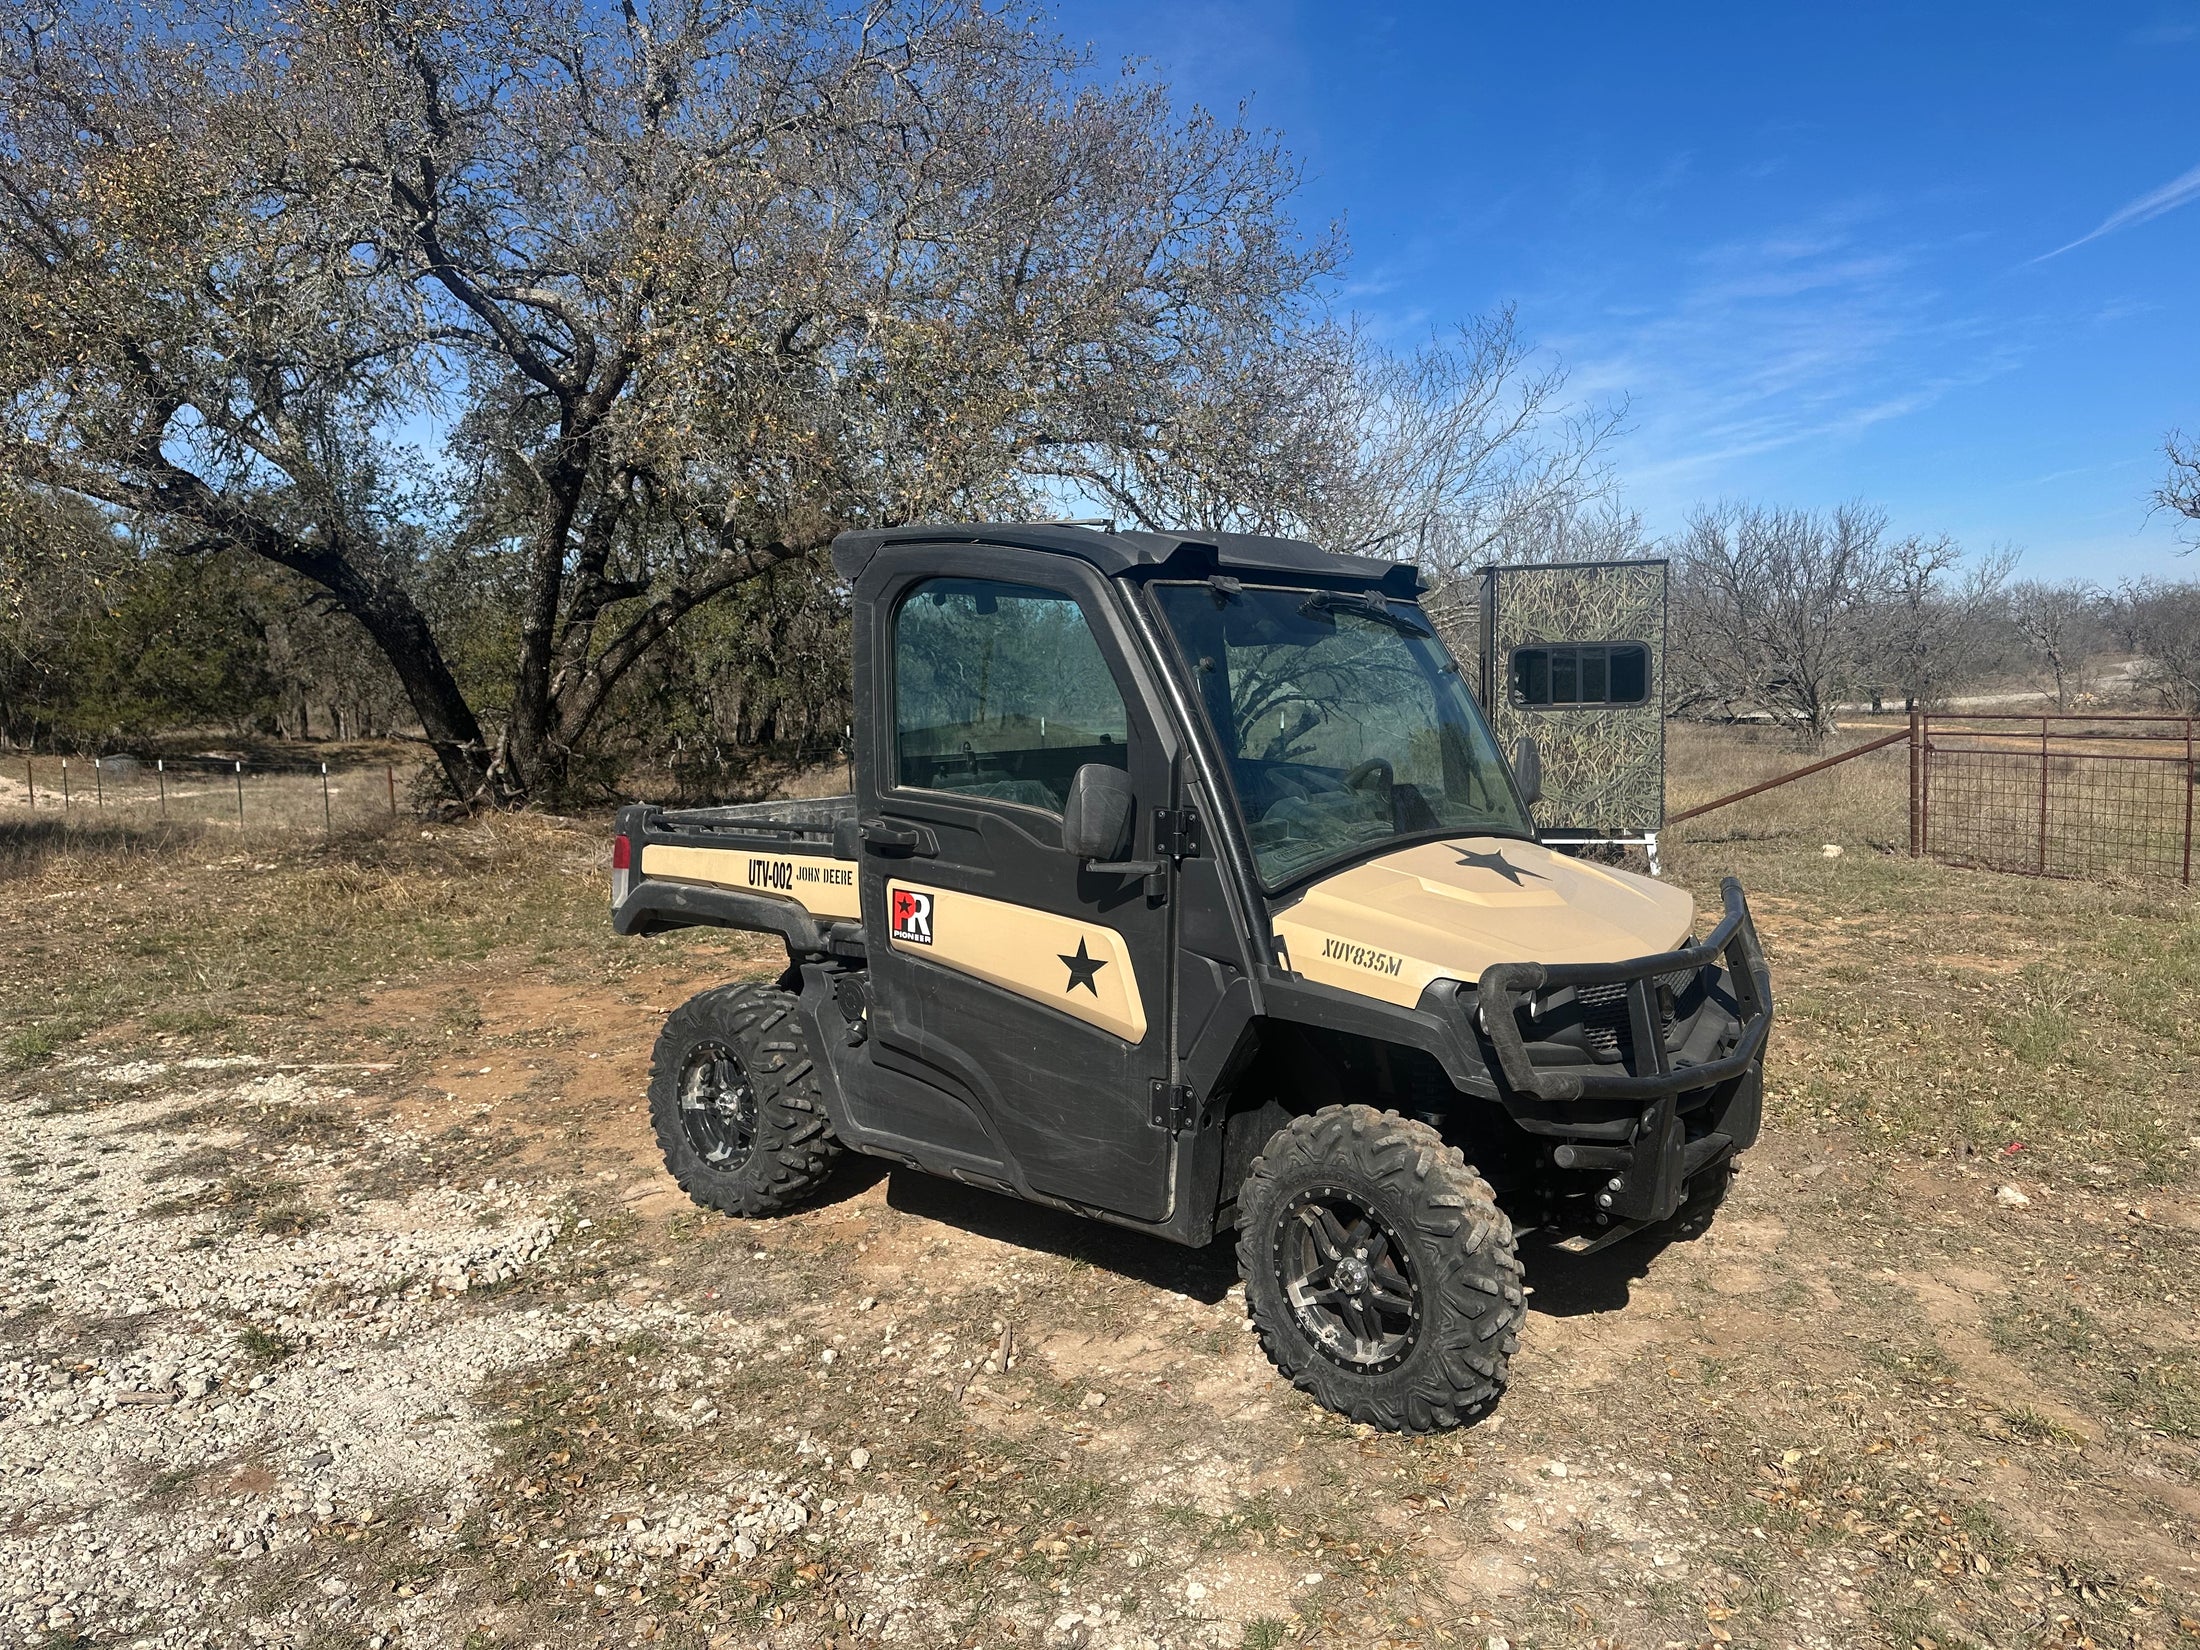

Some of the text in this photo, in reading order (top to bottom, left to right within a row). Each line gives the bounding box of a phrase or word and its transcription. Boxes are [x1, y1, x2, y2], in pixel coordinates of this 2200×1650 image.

[748, 859, 793, 890] UTV-002
[796, 866, 853, 885] JOHN DEERE
[893, 930, 932, 943] PIONEER
[1321, 938, 1403, 977] XUV835M
